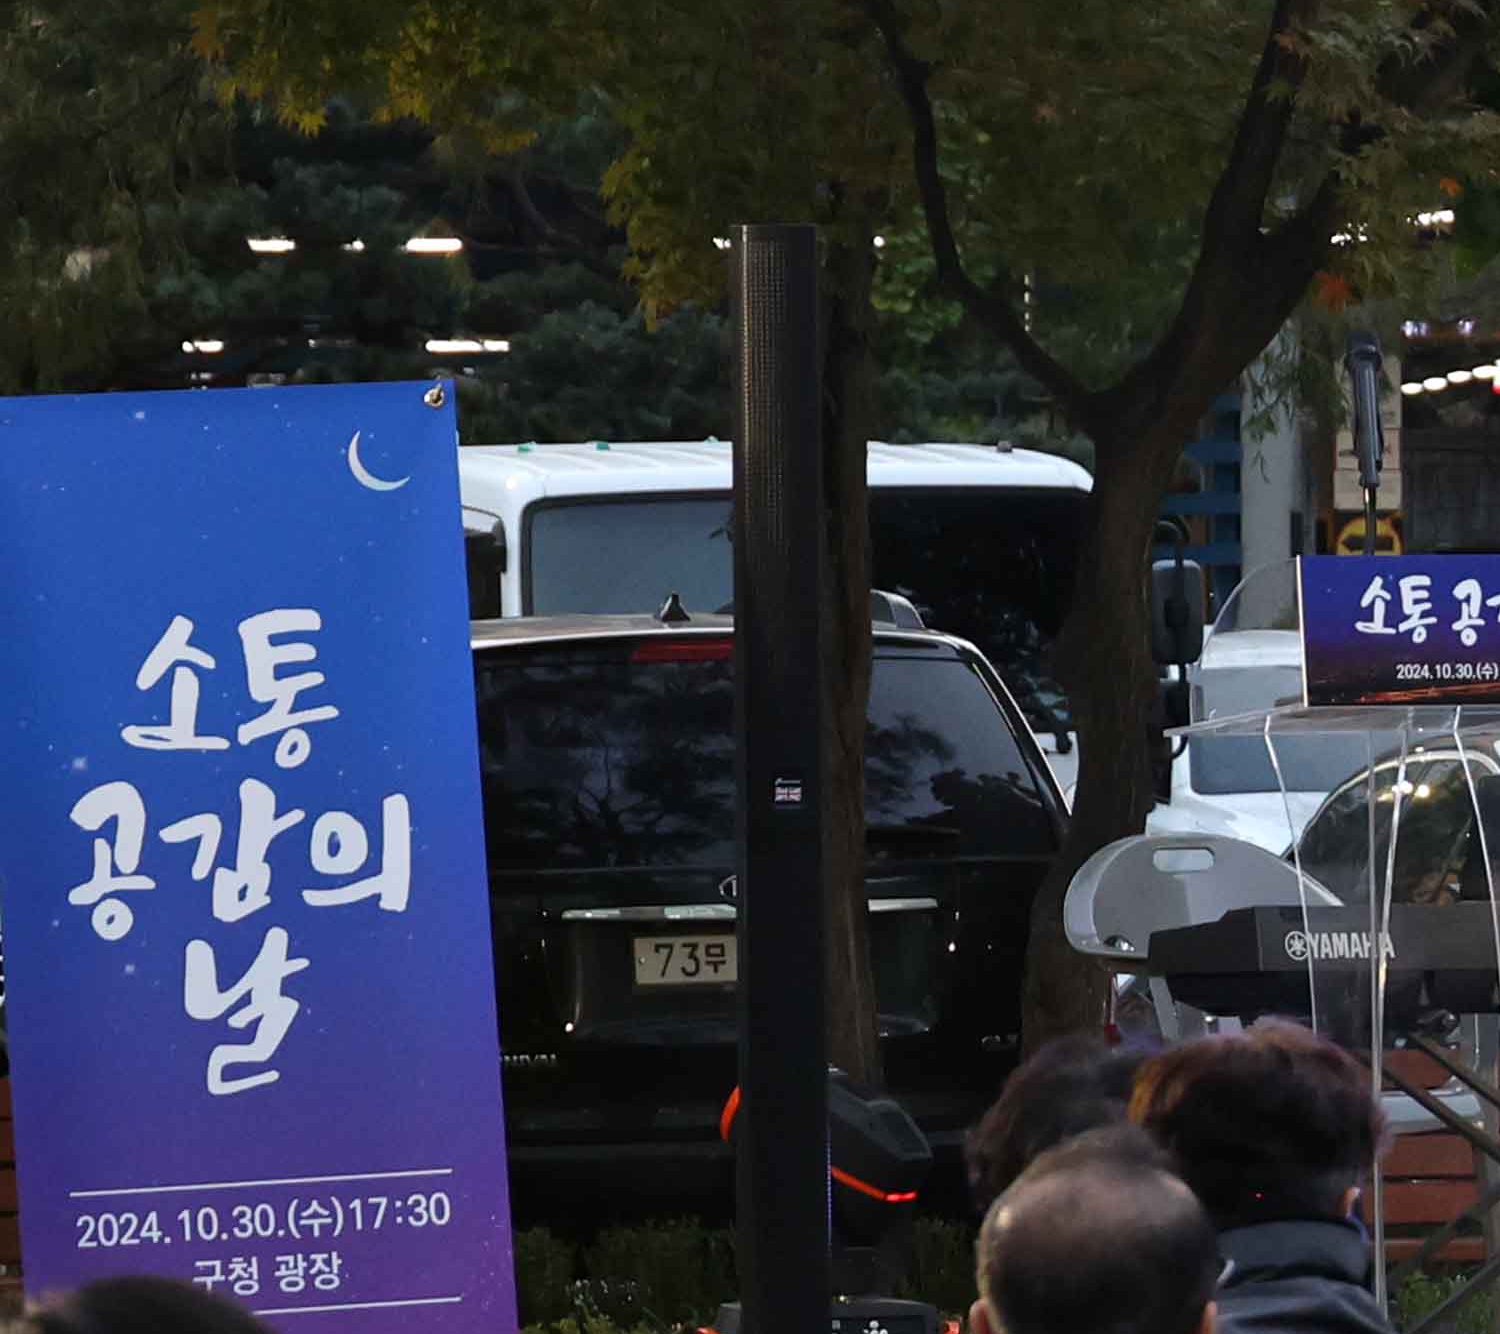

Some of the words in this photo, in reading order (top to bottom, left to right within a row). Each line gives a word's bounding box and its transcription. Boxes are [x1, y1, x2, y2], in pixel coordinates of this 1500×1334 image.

[121, 608, 339, 769] 소통
[1355, 574, 1438, 644] 소통
[68, 777, 412, 941] 공감의
[184, 927, 310, 1095] 날
[193, 1256, 259, 1296] 구청
[273, 1251, 343, 1293] 광장
